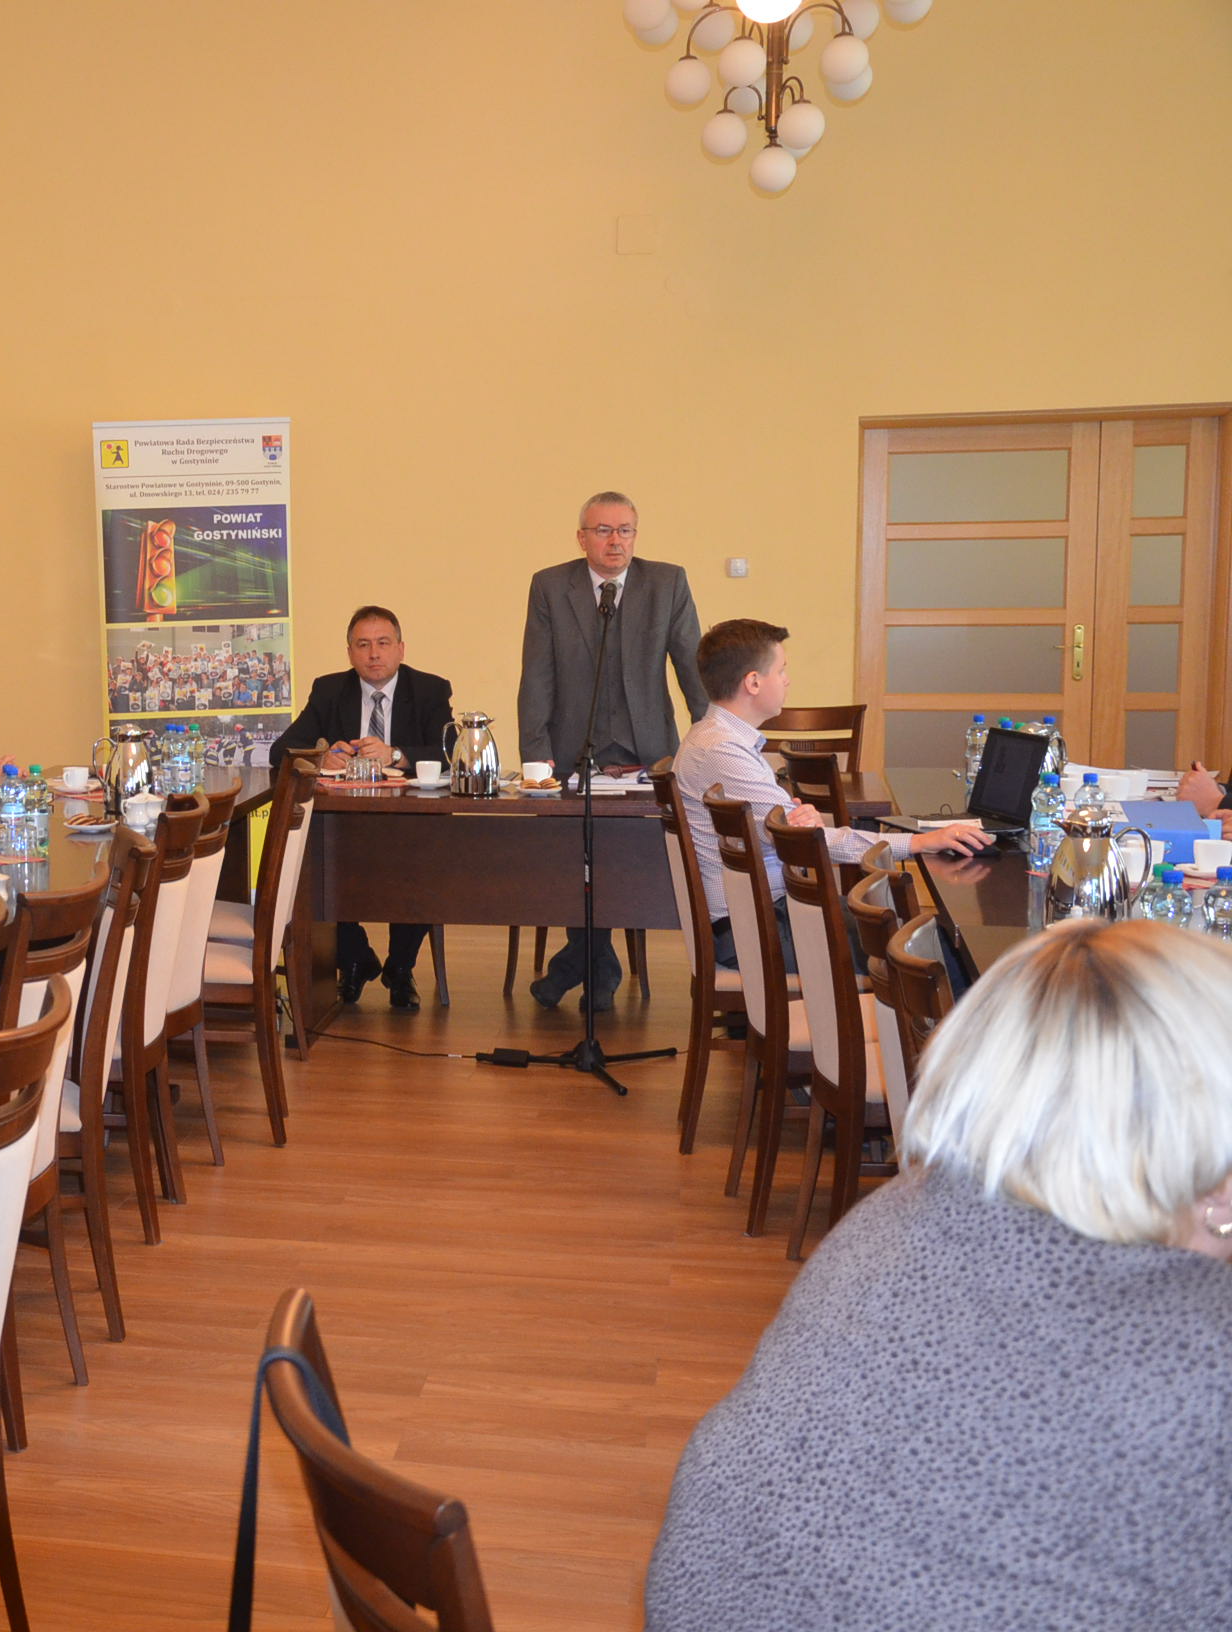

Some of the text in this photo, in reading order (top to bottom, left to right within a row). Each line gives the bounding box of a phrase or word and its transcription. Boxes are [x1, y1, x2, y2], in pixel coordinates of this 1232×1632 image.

[176, 438, 195, 446] Rada
[196, 437, 255, 447] Bezpieczeństwa
[161, 448, 229, 456] Ruchu Drogowego
[179, 457, 219, 466] Gostyninie
[213, 512, 263, 524] POWIAT
[194, 527, 282, 540] GOSTYNIŃSKI
